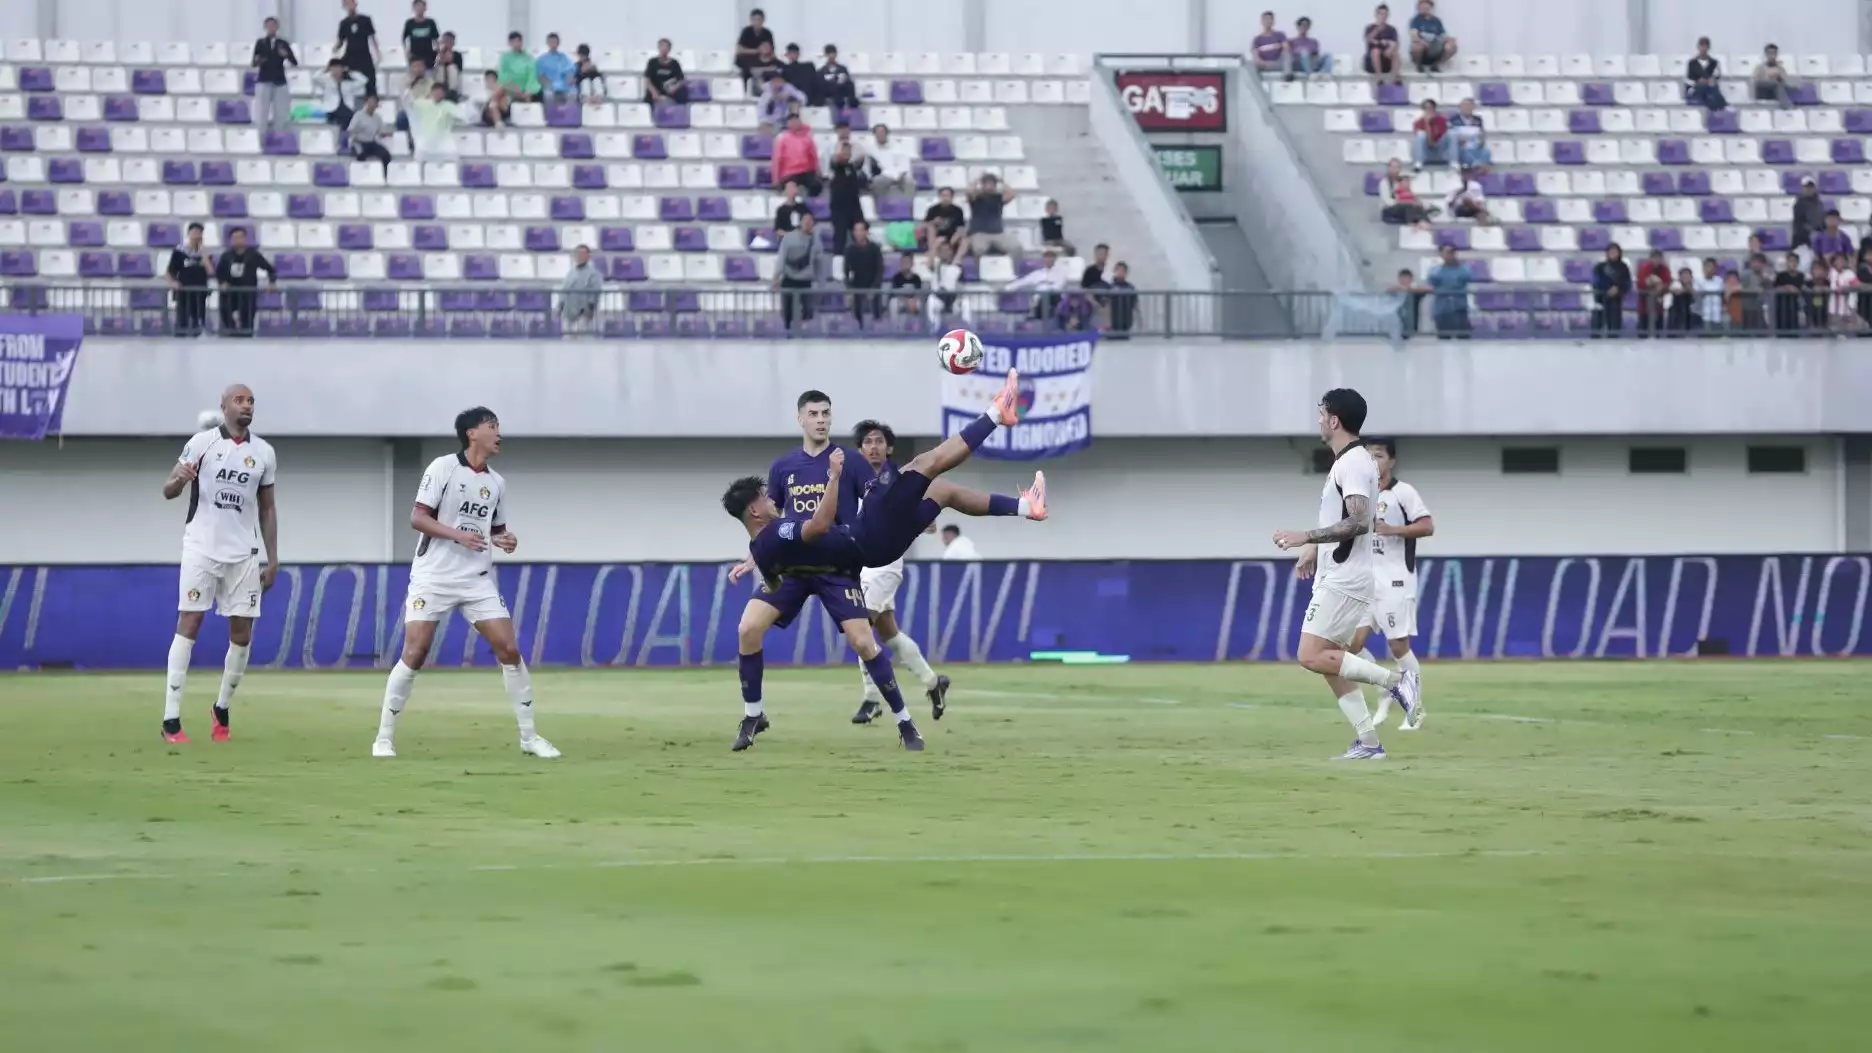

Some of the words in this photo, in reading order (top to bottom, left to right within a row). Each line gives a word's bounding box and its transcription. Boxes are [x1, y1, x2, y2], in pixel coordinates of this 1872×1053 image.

[1015, 340, 1092, 374] ADORED
[216, 468, 250, 484] AFG
[459, 500, 489, 518] AFG
[250, 594, 257, 607] 5
[1306, 607, 1316, 622] 3
[1387, 614, 1396, 628] 6
